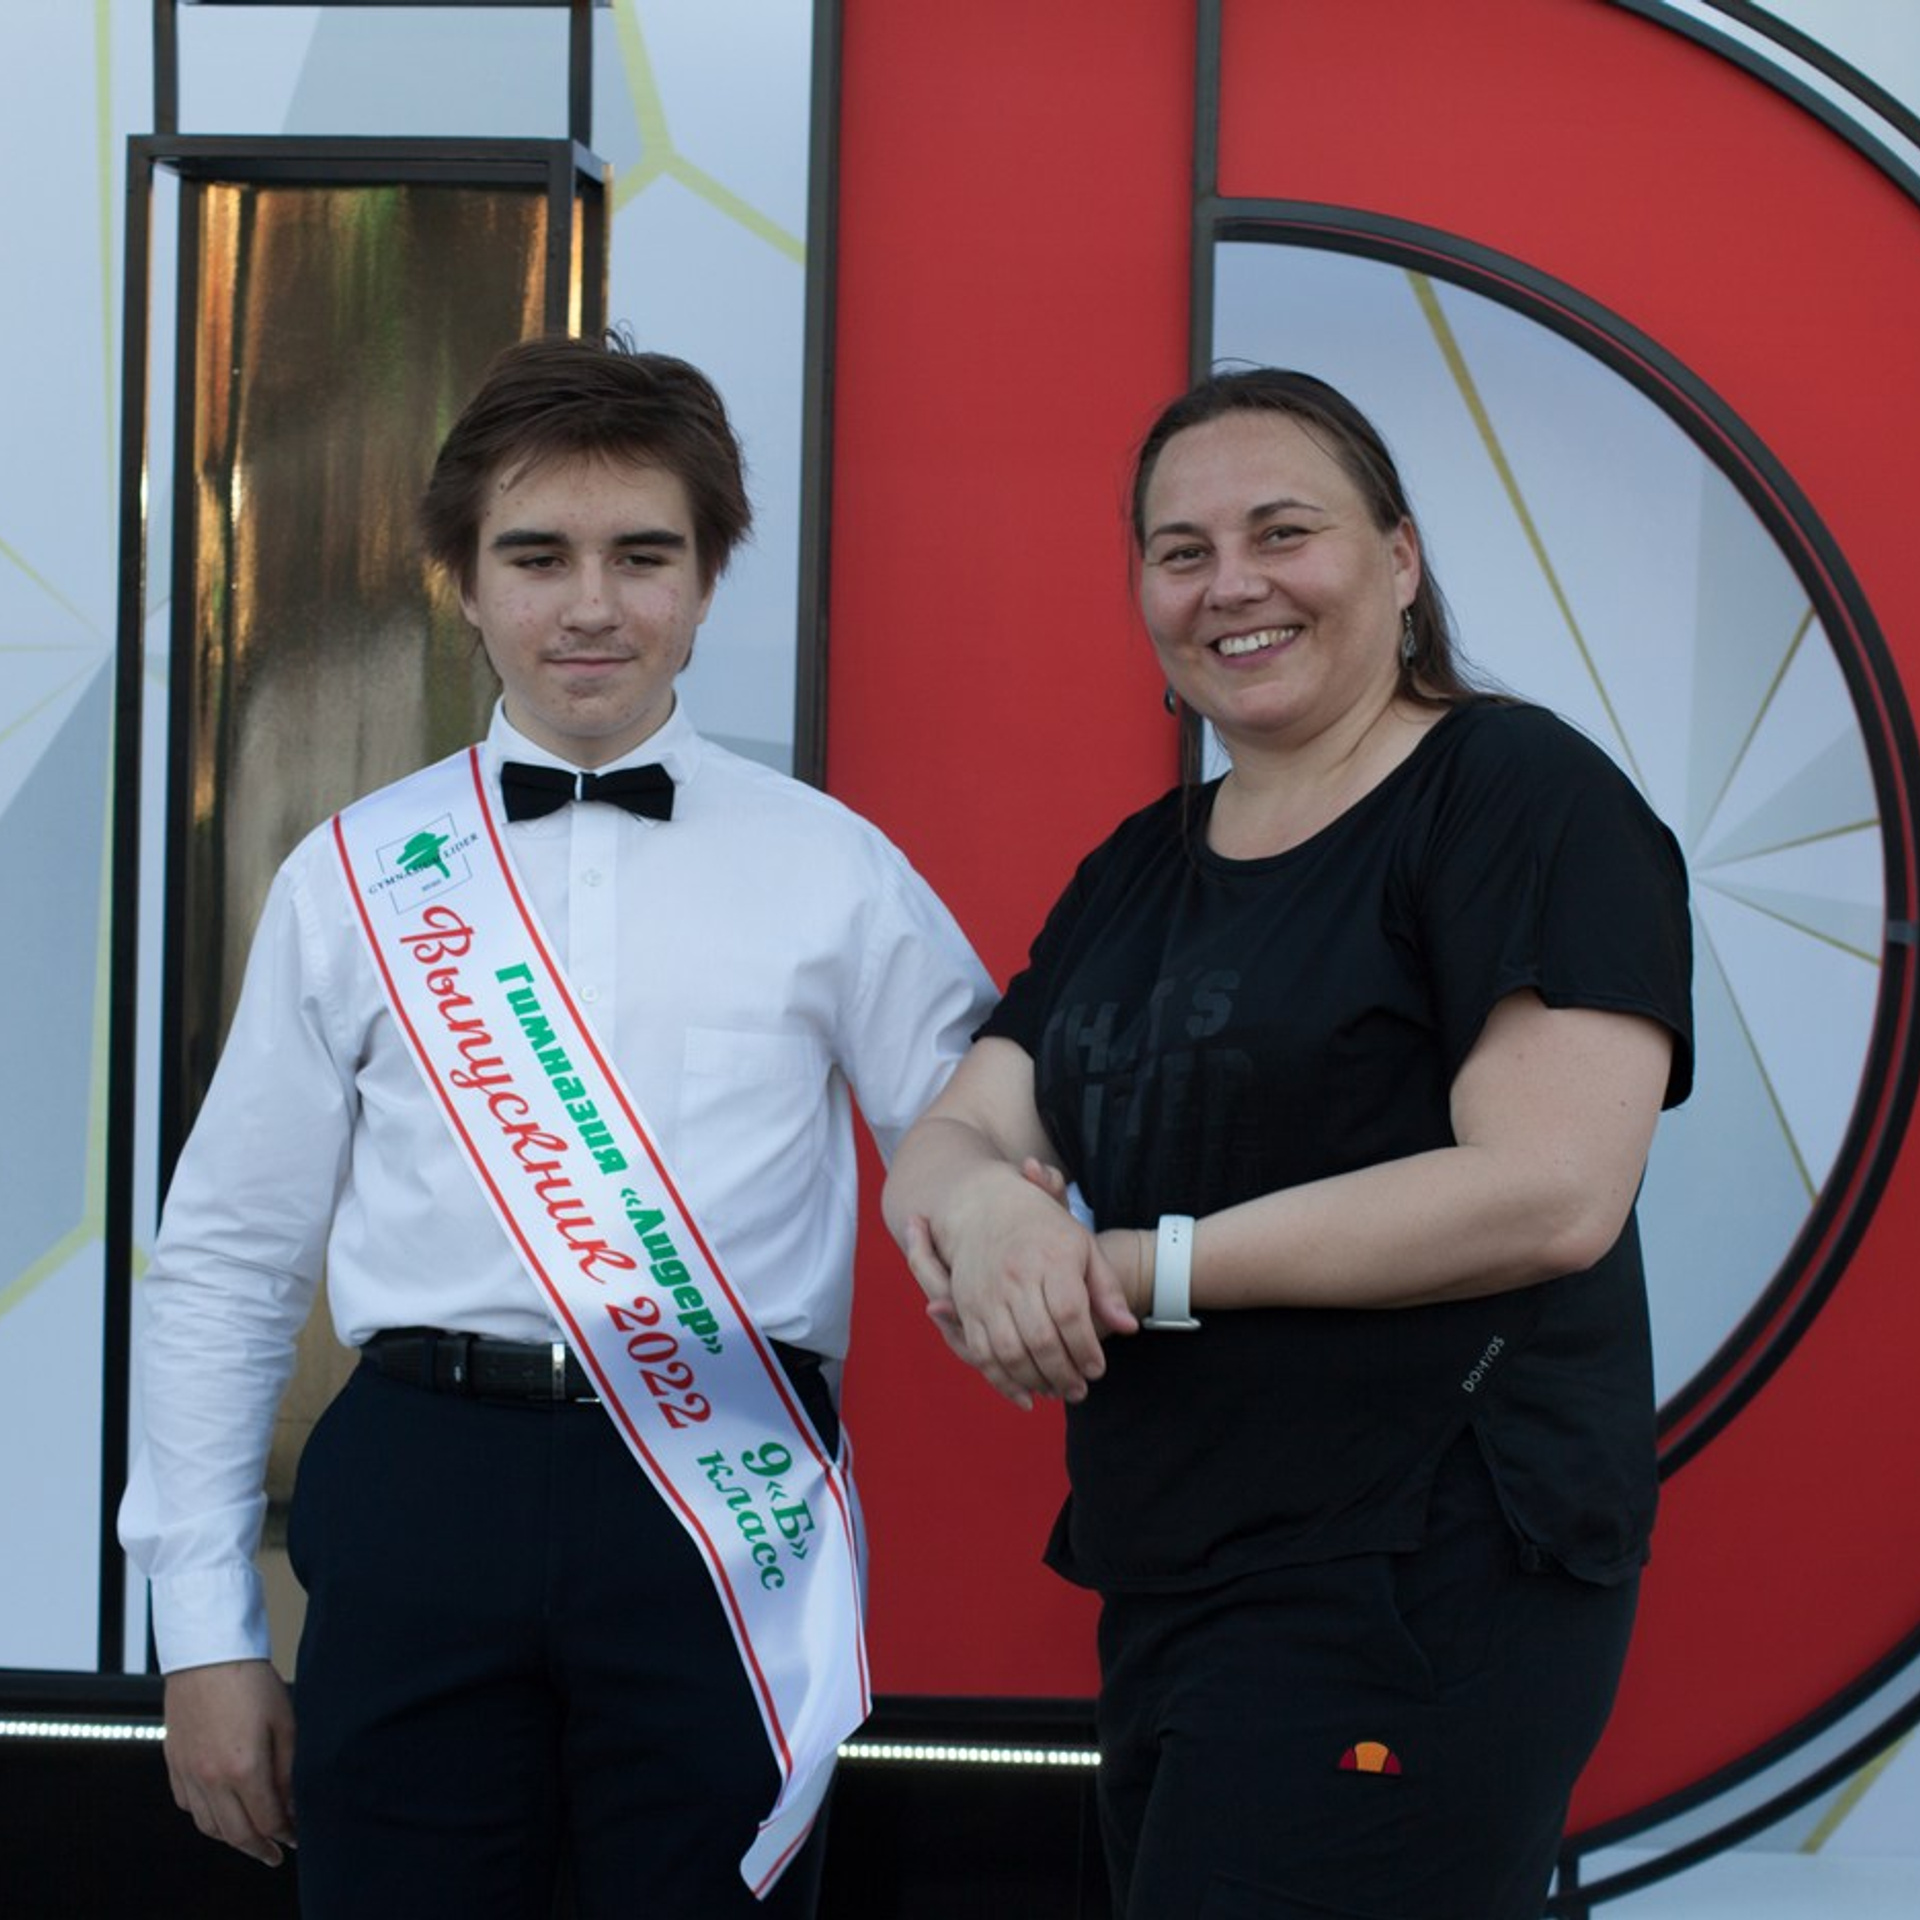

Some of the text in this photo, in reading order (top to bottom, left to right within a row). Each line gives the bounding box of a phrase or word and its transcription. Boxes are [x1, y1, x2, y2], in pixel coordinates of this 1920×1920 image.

[443, 833, 479, 860] LIDER
[399, 905, 712, 1430] Выпускник 2022
[495, 962, 723, 1355] Гимназия «Лидер»
[1461, 1335, 1505, 1392] DOMYOS
[697, 1450, 785, 1591] класс
